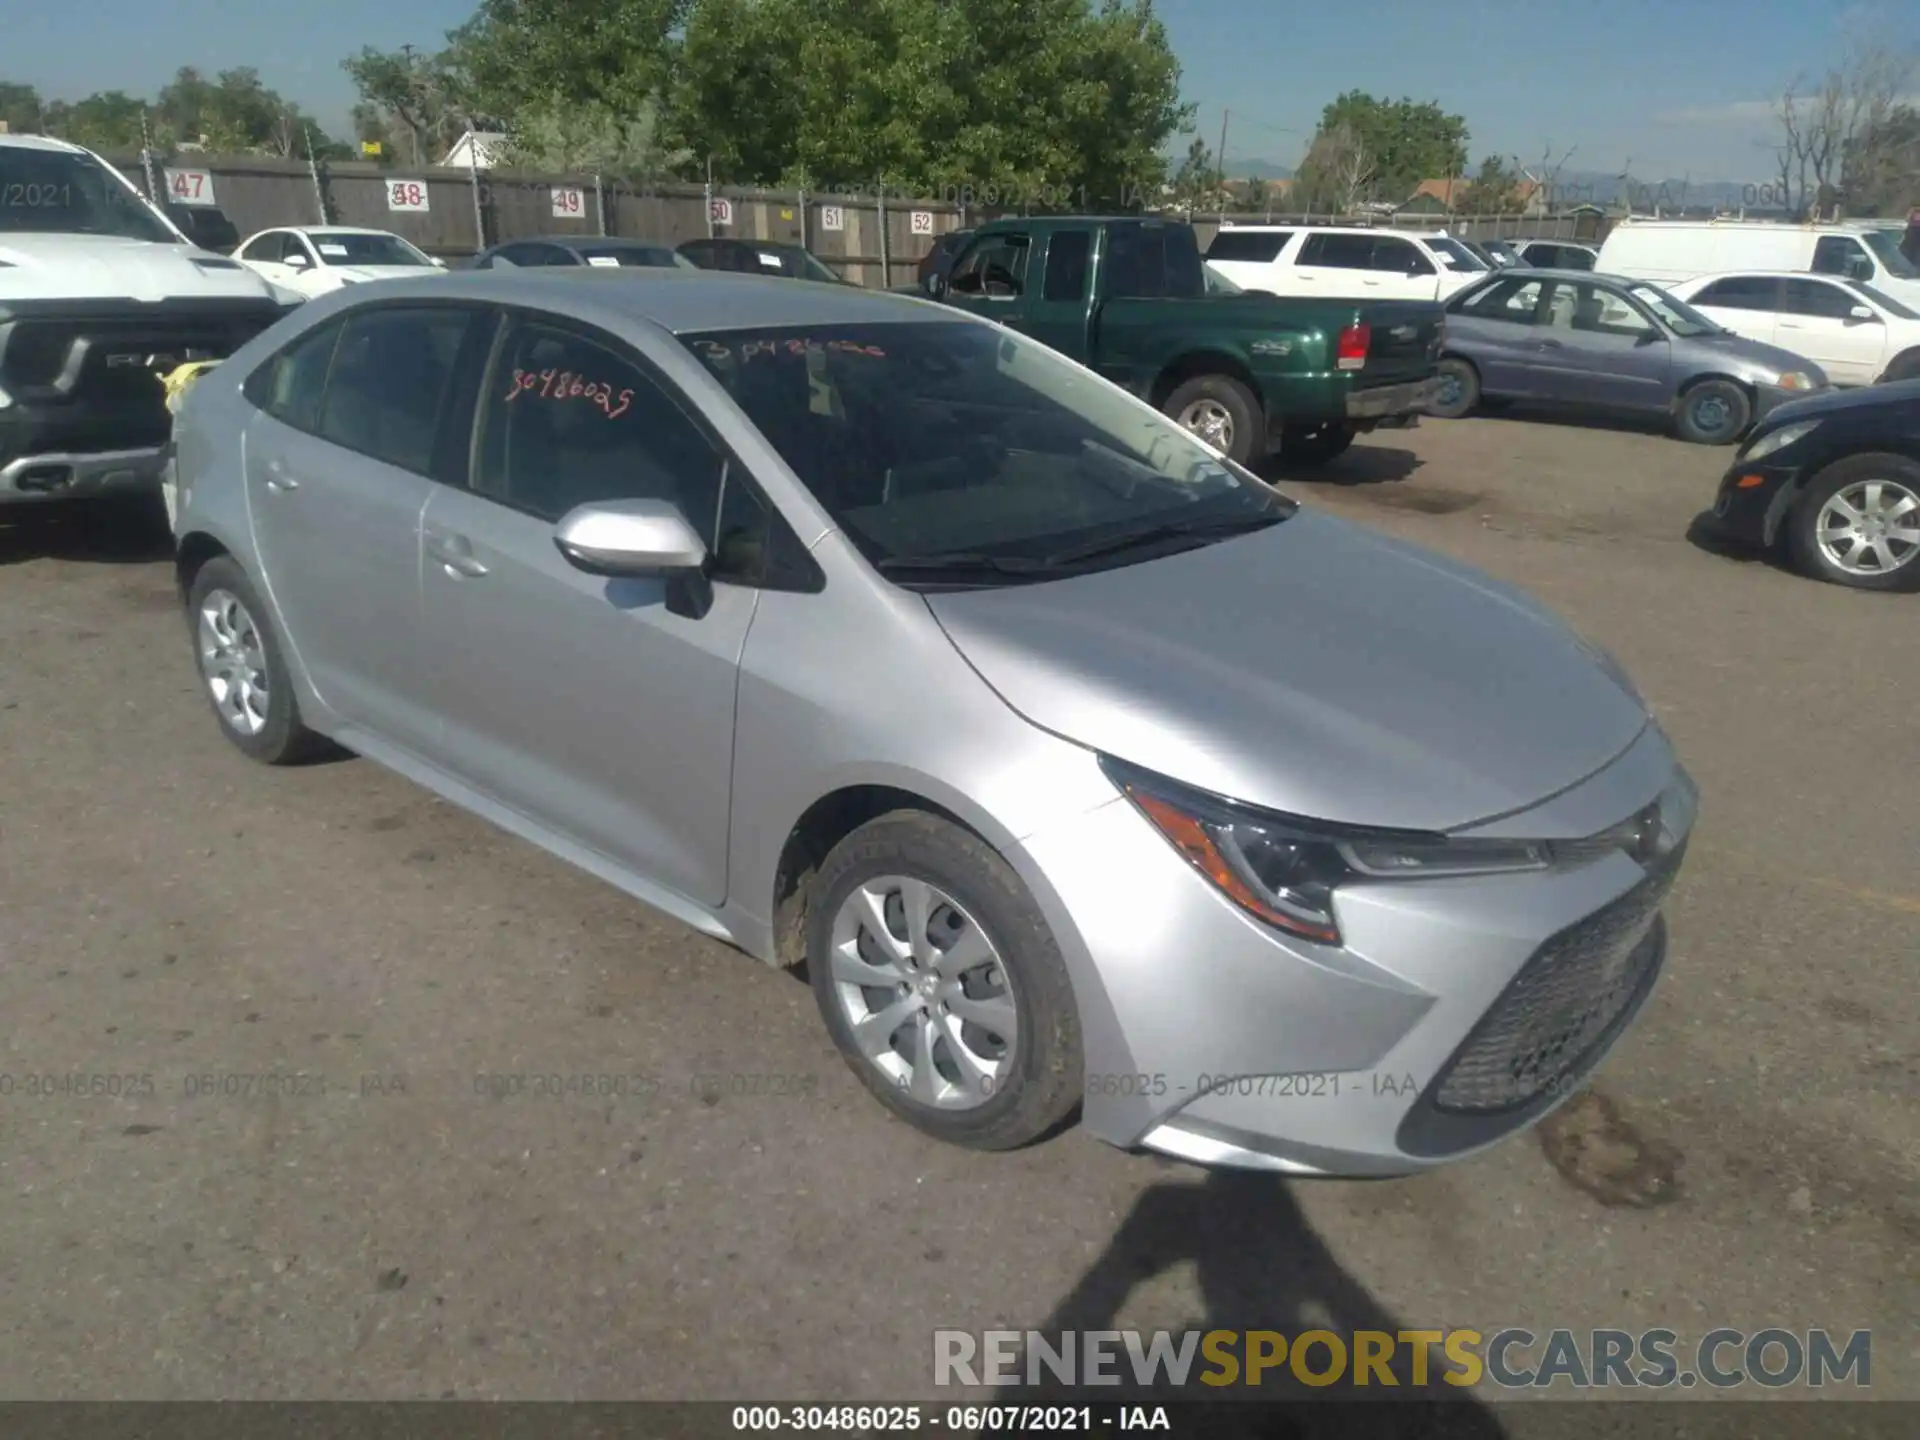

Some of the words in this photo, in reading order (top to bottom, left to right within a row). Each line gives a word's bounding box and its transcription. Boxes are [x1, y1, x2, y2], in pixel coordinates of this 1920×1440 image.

[175, 173, 204, 198] 47
[556, 187, 580, 212] 49
[709, 201, 729, 220] 50
[825, 210, 840, 226] 51
[914, 213, 930, 231] 52
[504, 367, 635, 419] 30486025
